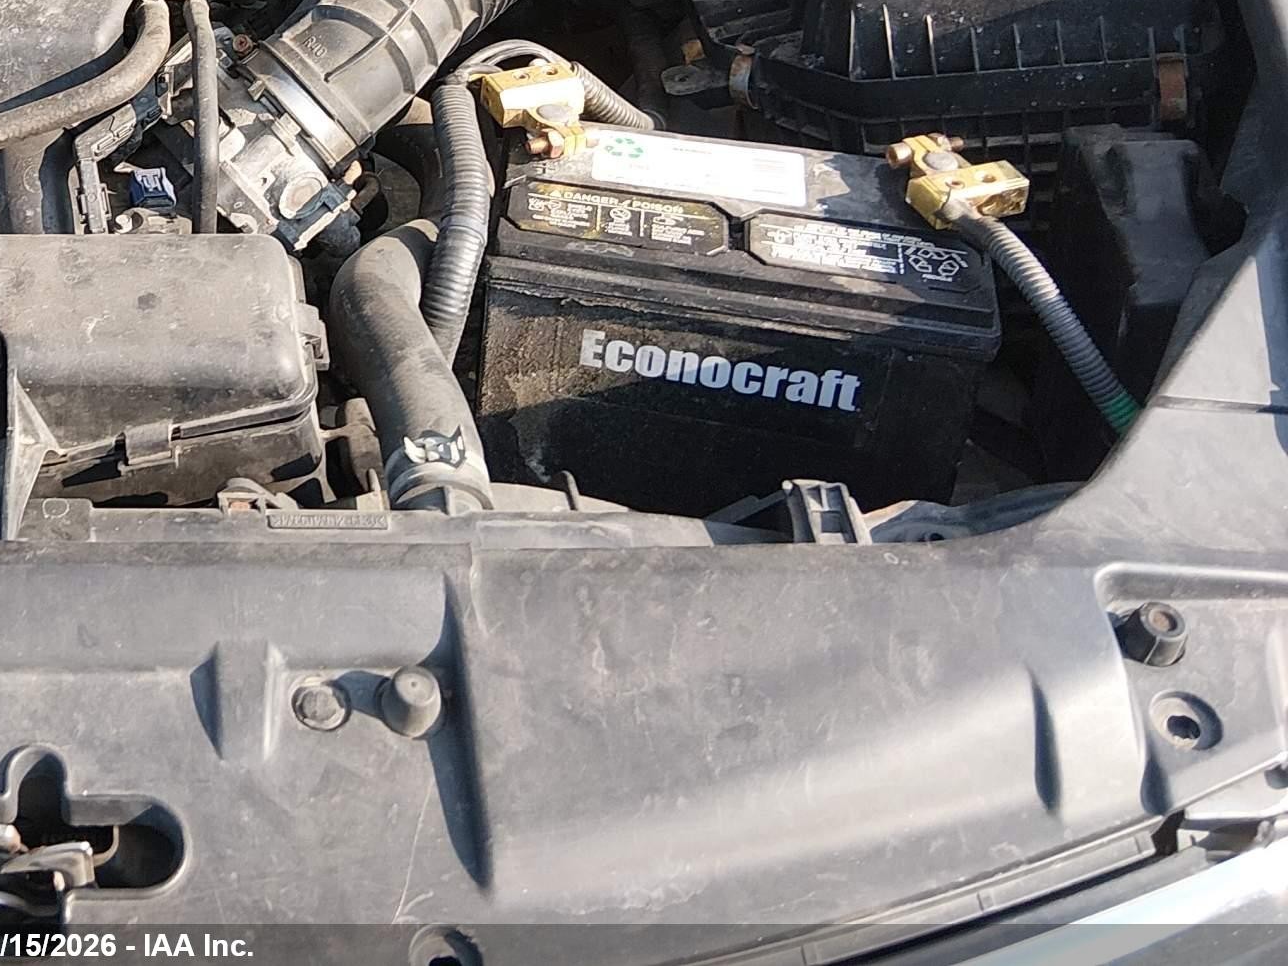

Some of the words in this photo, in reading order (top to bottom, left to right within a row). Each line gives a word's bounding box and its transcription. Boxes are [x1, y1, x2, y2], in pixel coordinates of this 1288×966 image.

[564, 192, 619, 205] DANGER
[632, 200, 684, 214] POISON
[579, 328, 861, 413] Econocraft
